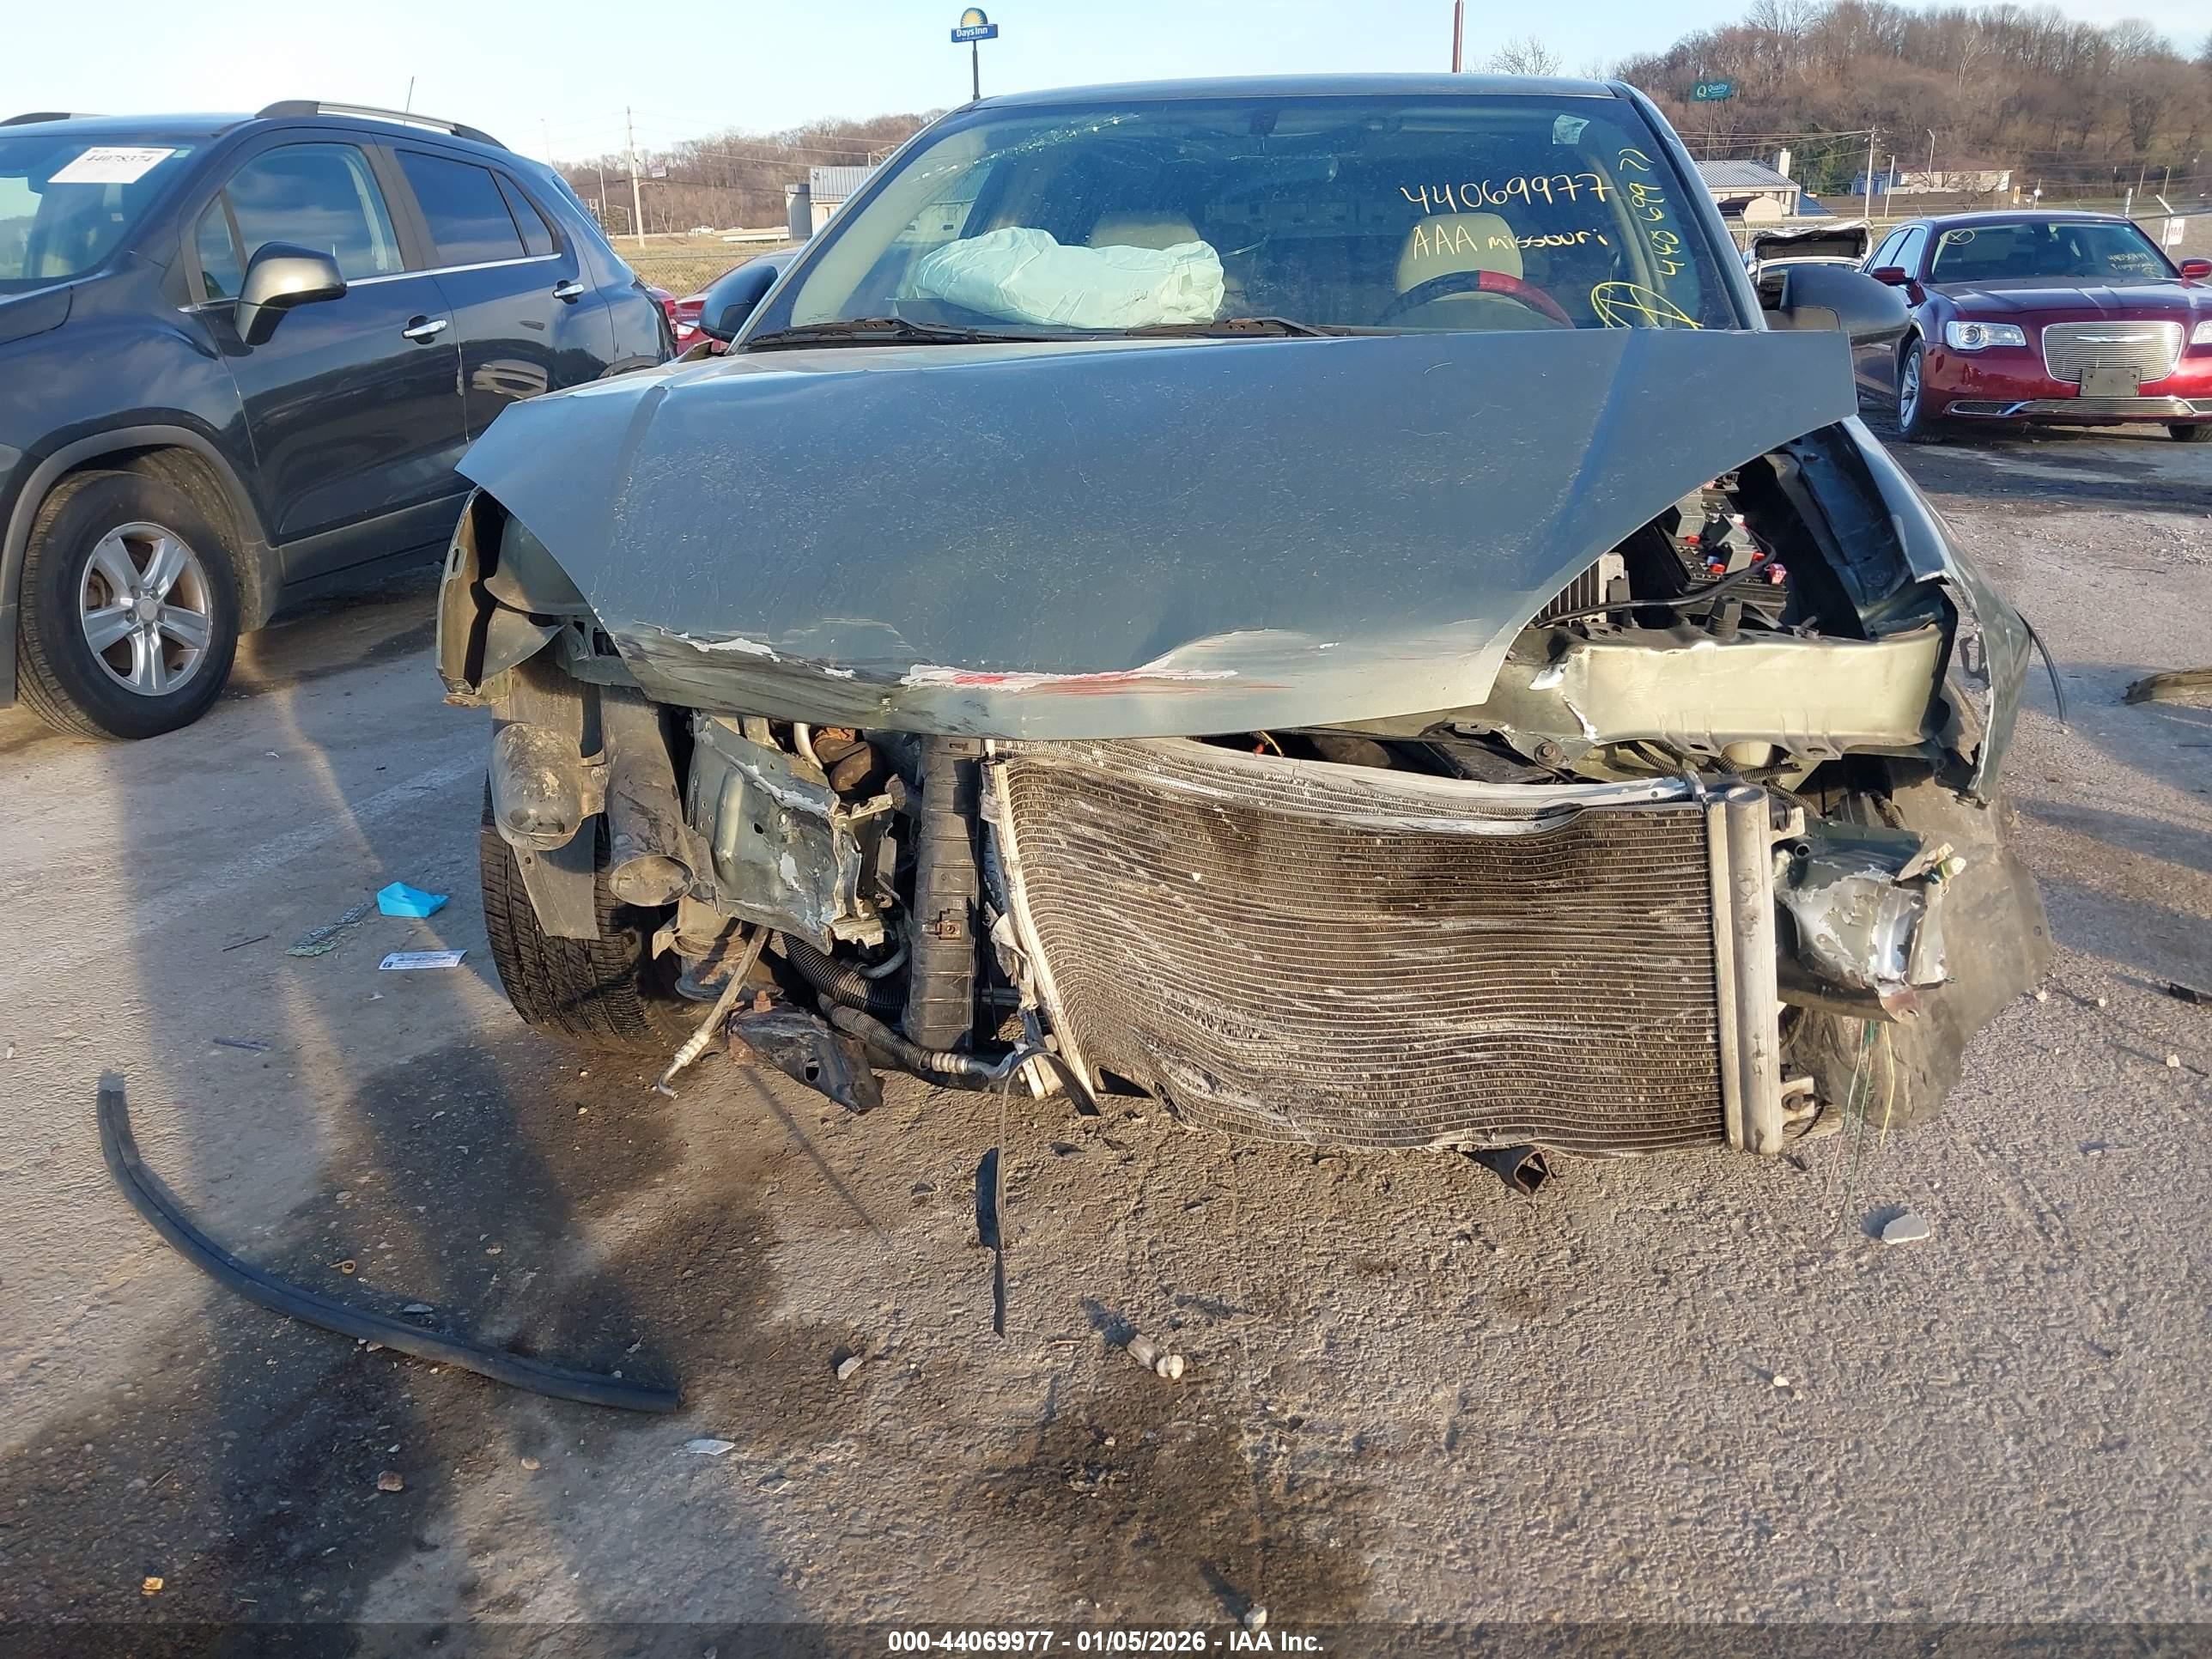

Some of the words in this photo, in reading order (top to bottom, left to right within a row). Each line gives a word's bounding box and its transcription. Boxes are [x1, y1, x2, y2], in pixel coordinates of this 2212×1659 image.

[956, 28, 975, 38] Days
[975, 27, 988, 35] Inn
[1707, 83, 1729, 93] Quality
[1400, 173, 1615, 214] 44069977
[1413, 223, 1478, 260] AAA
